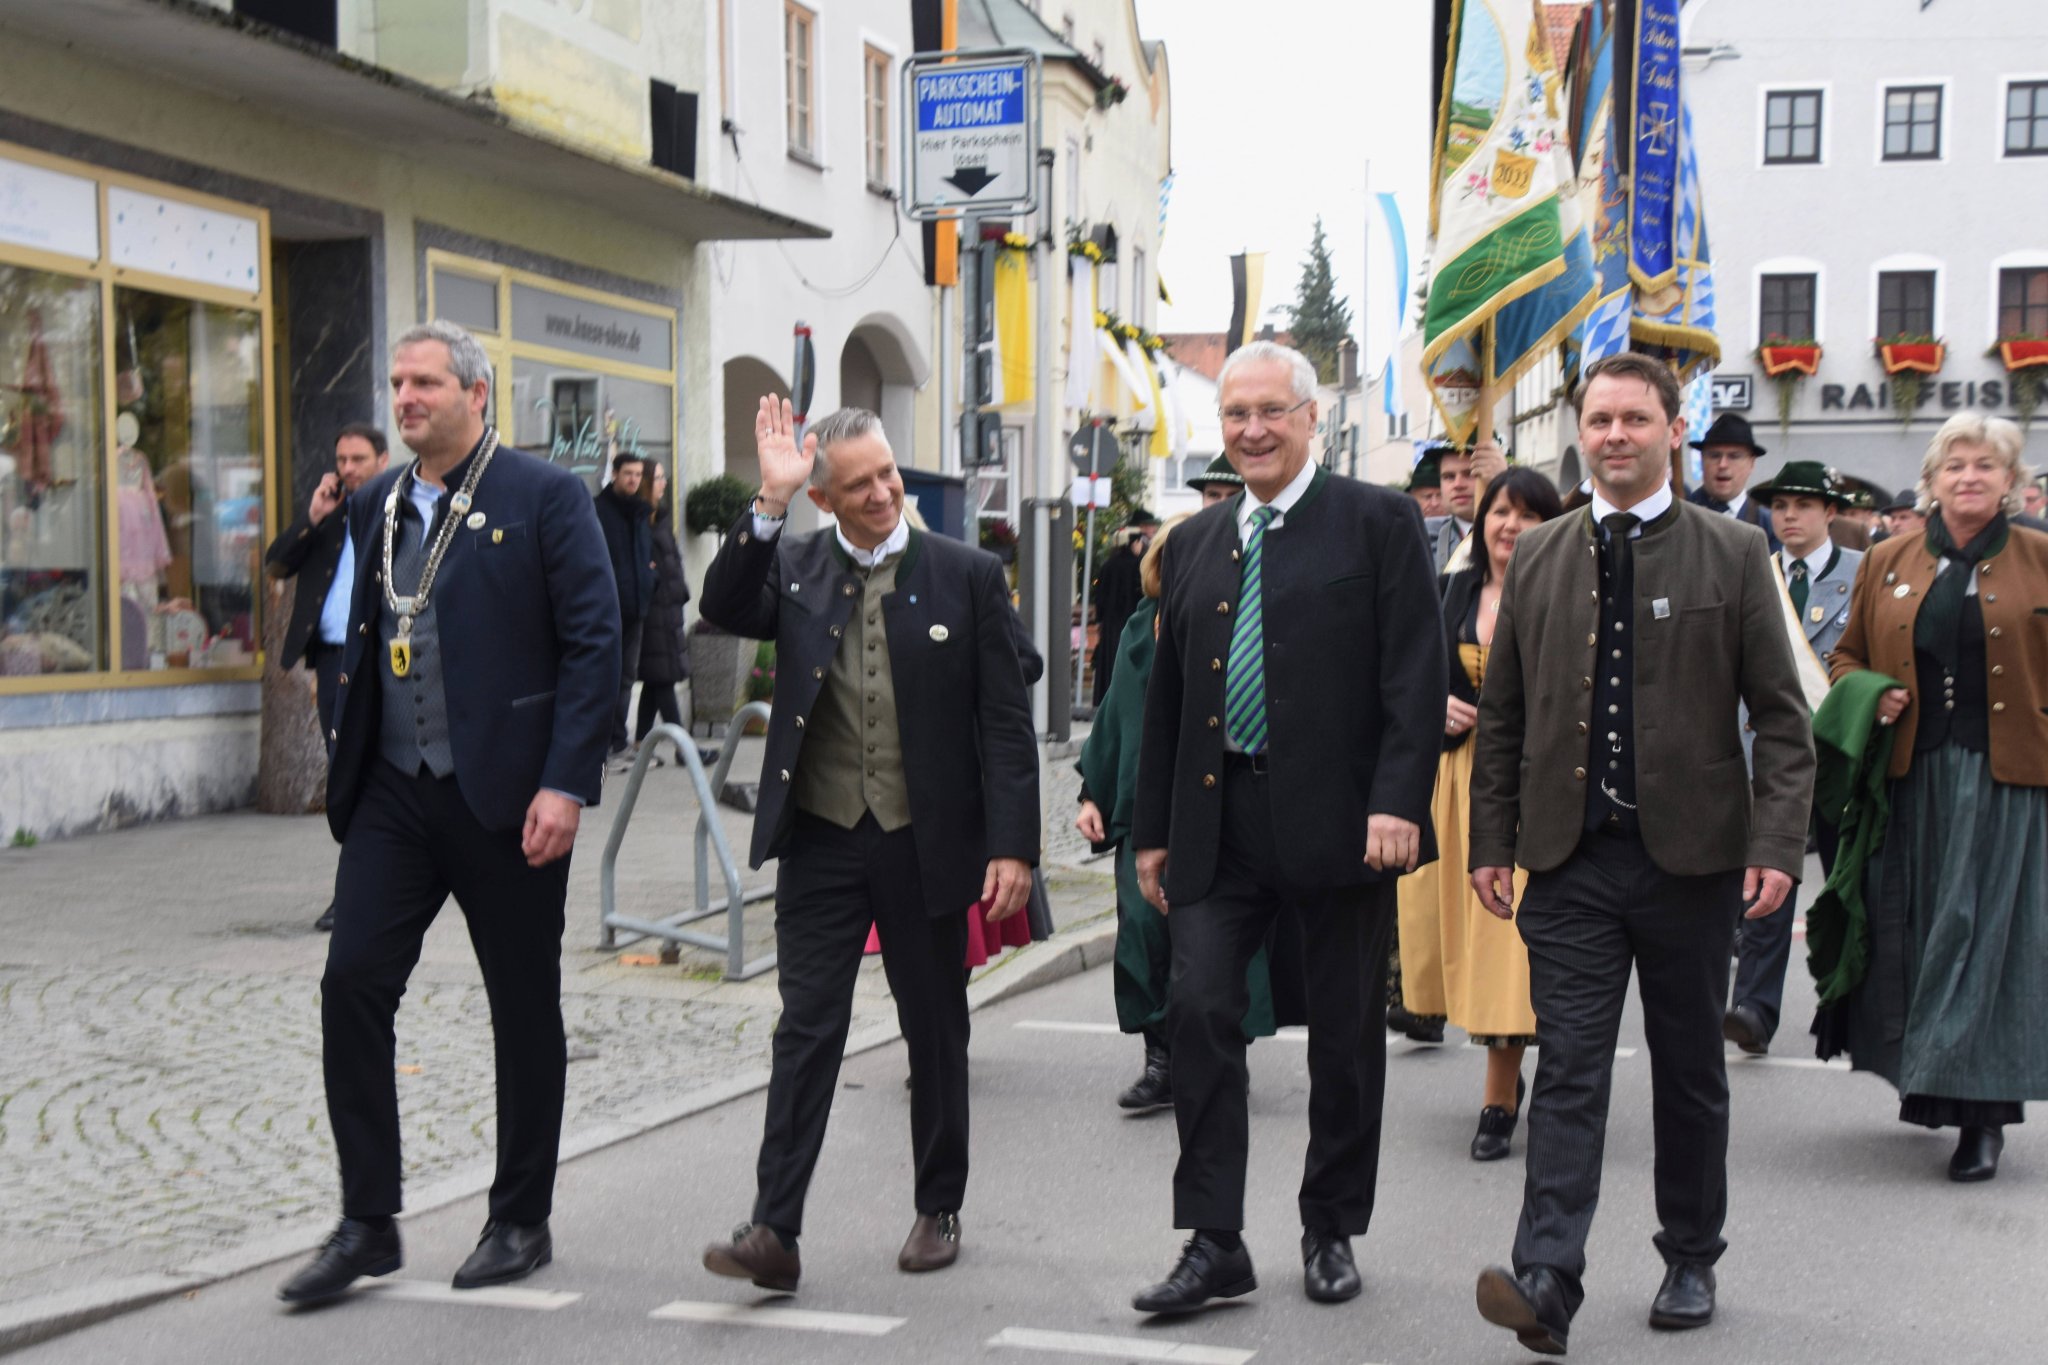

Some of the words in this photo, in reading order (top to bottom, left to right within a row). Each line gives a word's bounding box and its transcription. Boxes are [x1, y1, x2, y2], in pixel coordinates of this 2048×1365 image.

[919, 71, 1022, 102] PARKSCHEIN-
[933, 99, 1005, 128] AUTOMAT
[919, 136, 948, 152] Hier
[951, 131, 1022, 150] Parkschein
